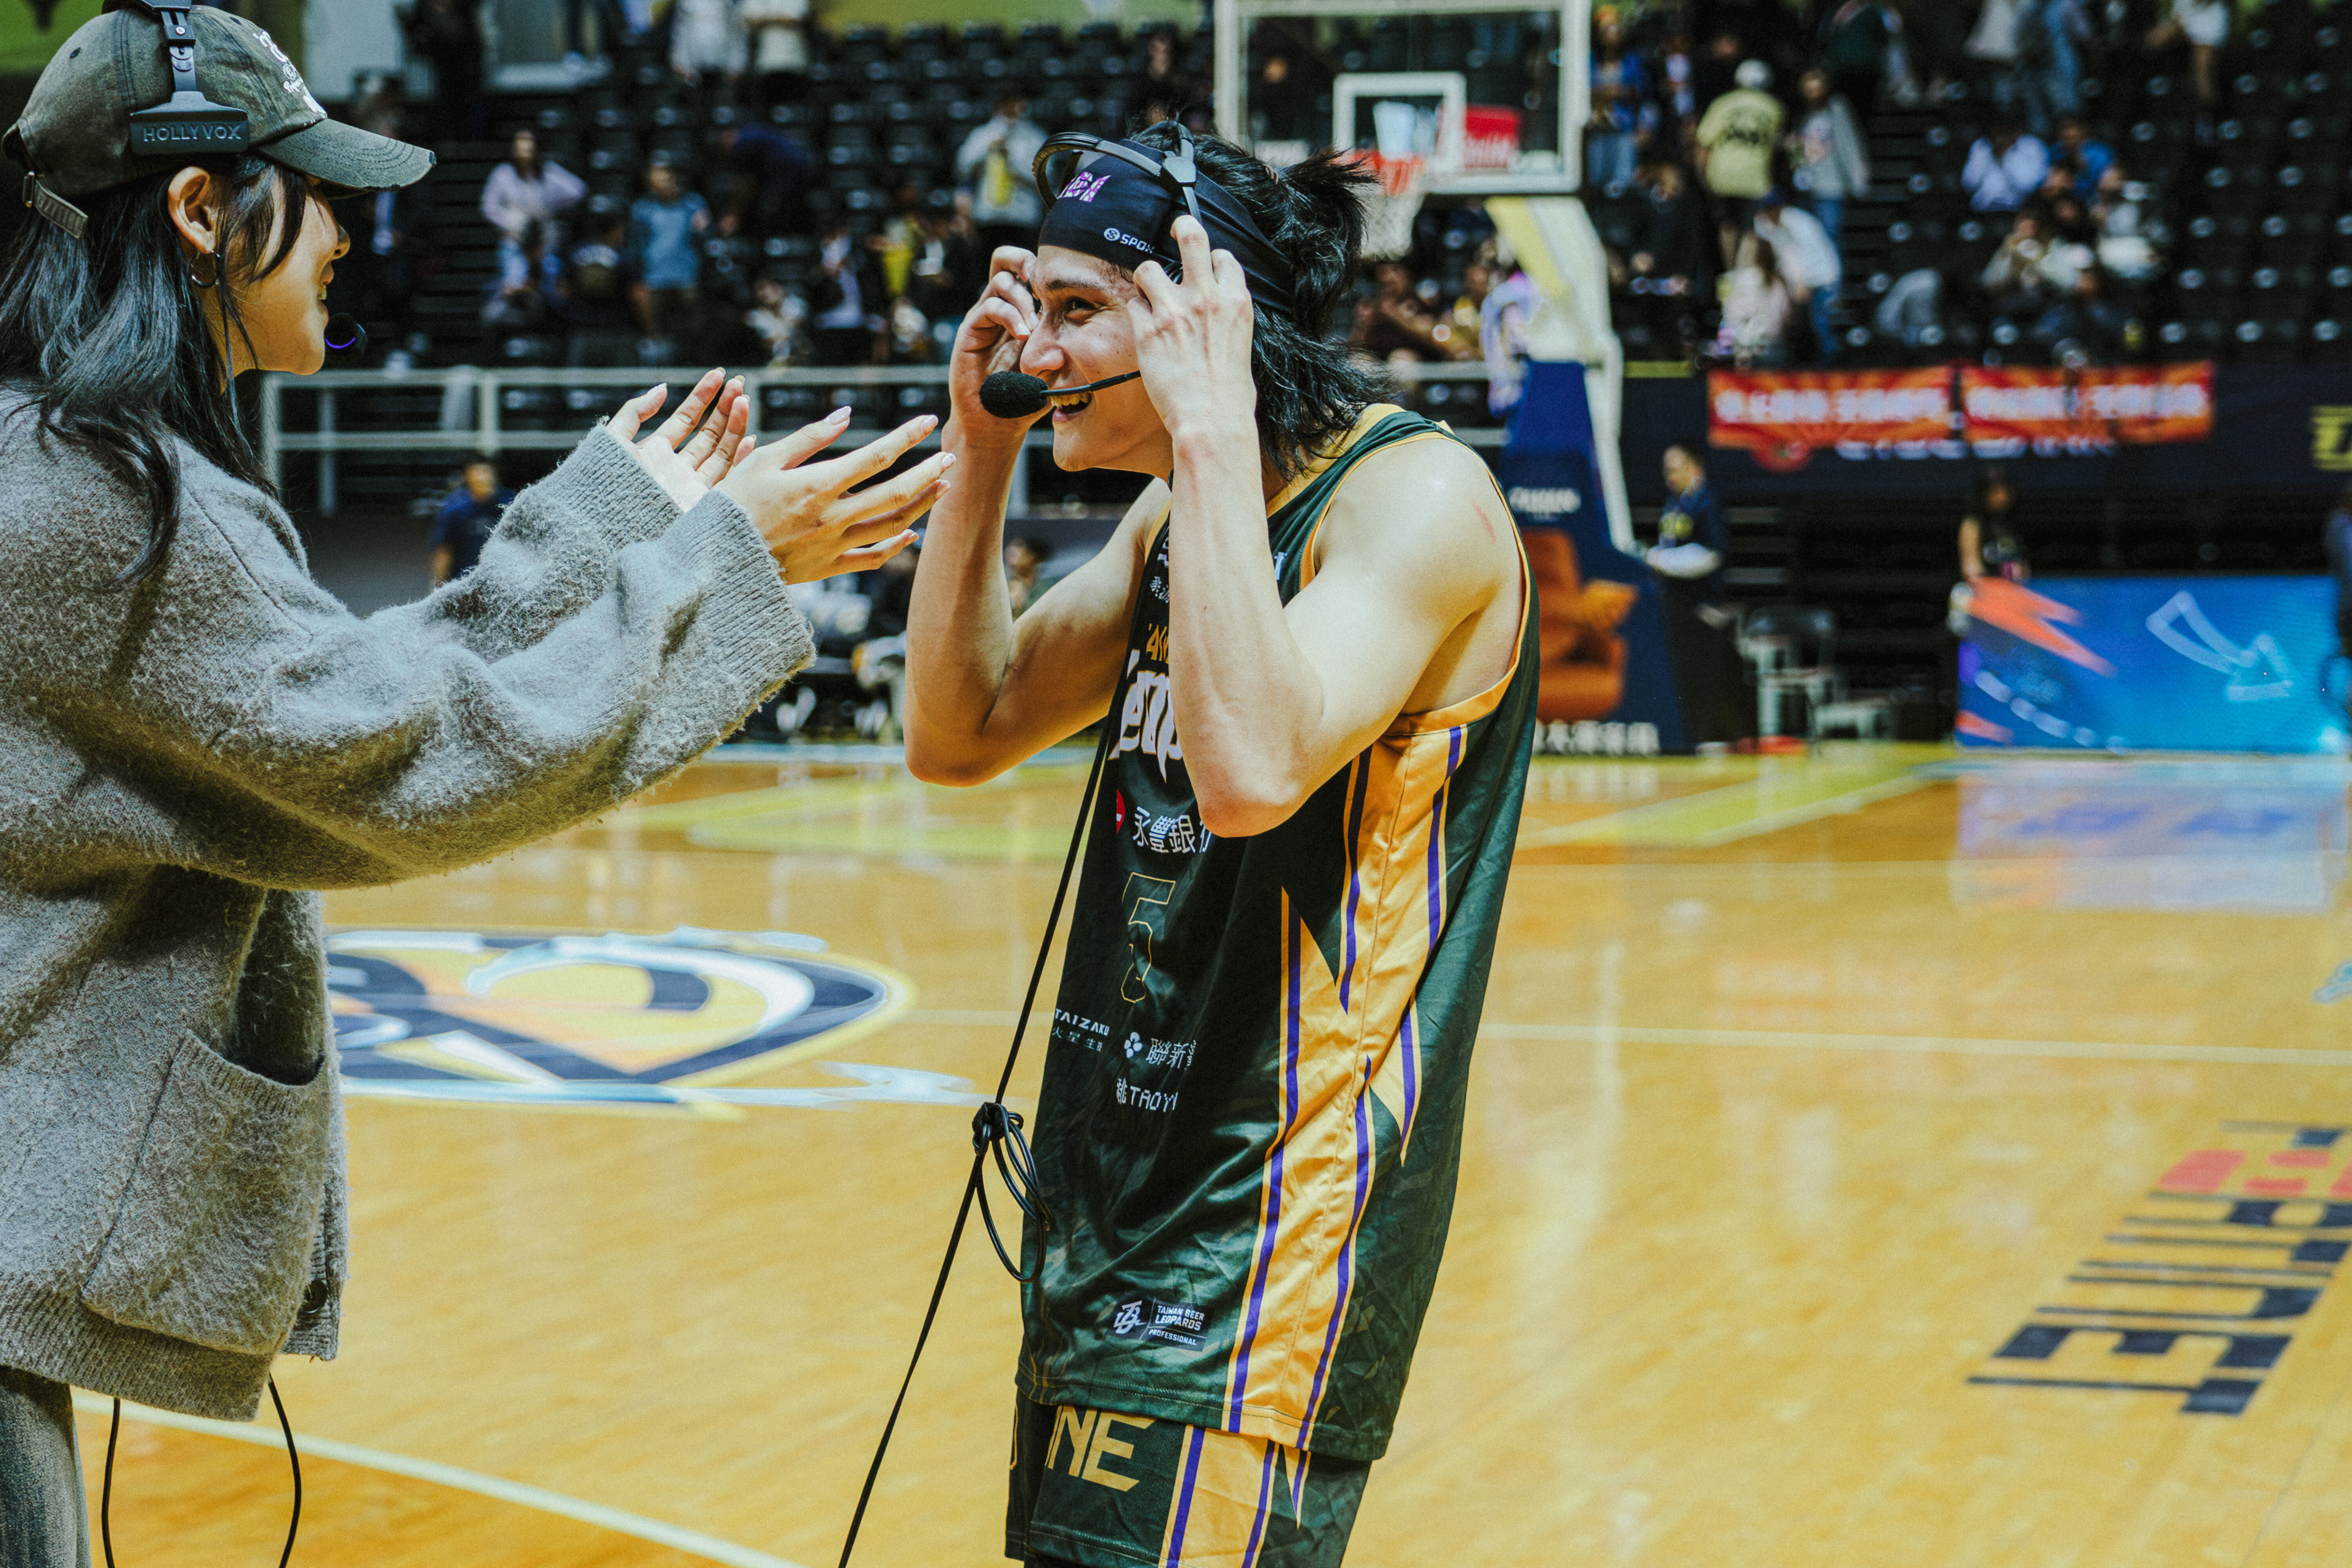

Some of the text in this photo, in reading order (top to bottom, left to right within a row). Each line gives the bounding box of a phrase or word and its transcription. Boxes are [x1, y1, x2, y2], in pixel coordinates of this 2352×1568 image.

[143, 125, 241, 142] HOLLYVOX
[1157, 1305, 1205, 1321] TAIWAN BEER
[1154, 1314, 1202, 1331] LEOPARDS
[1148, 1328, 1197, 1346] PROFESSIONAL
